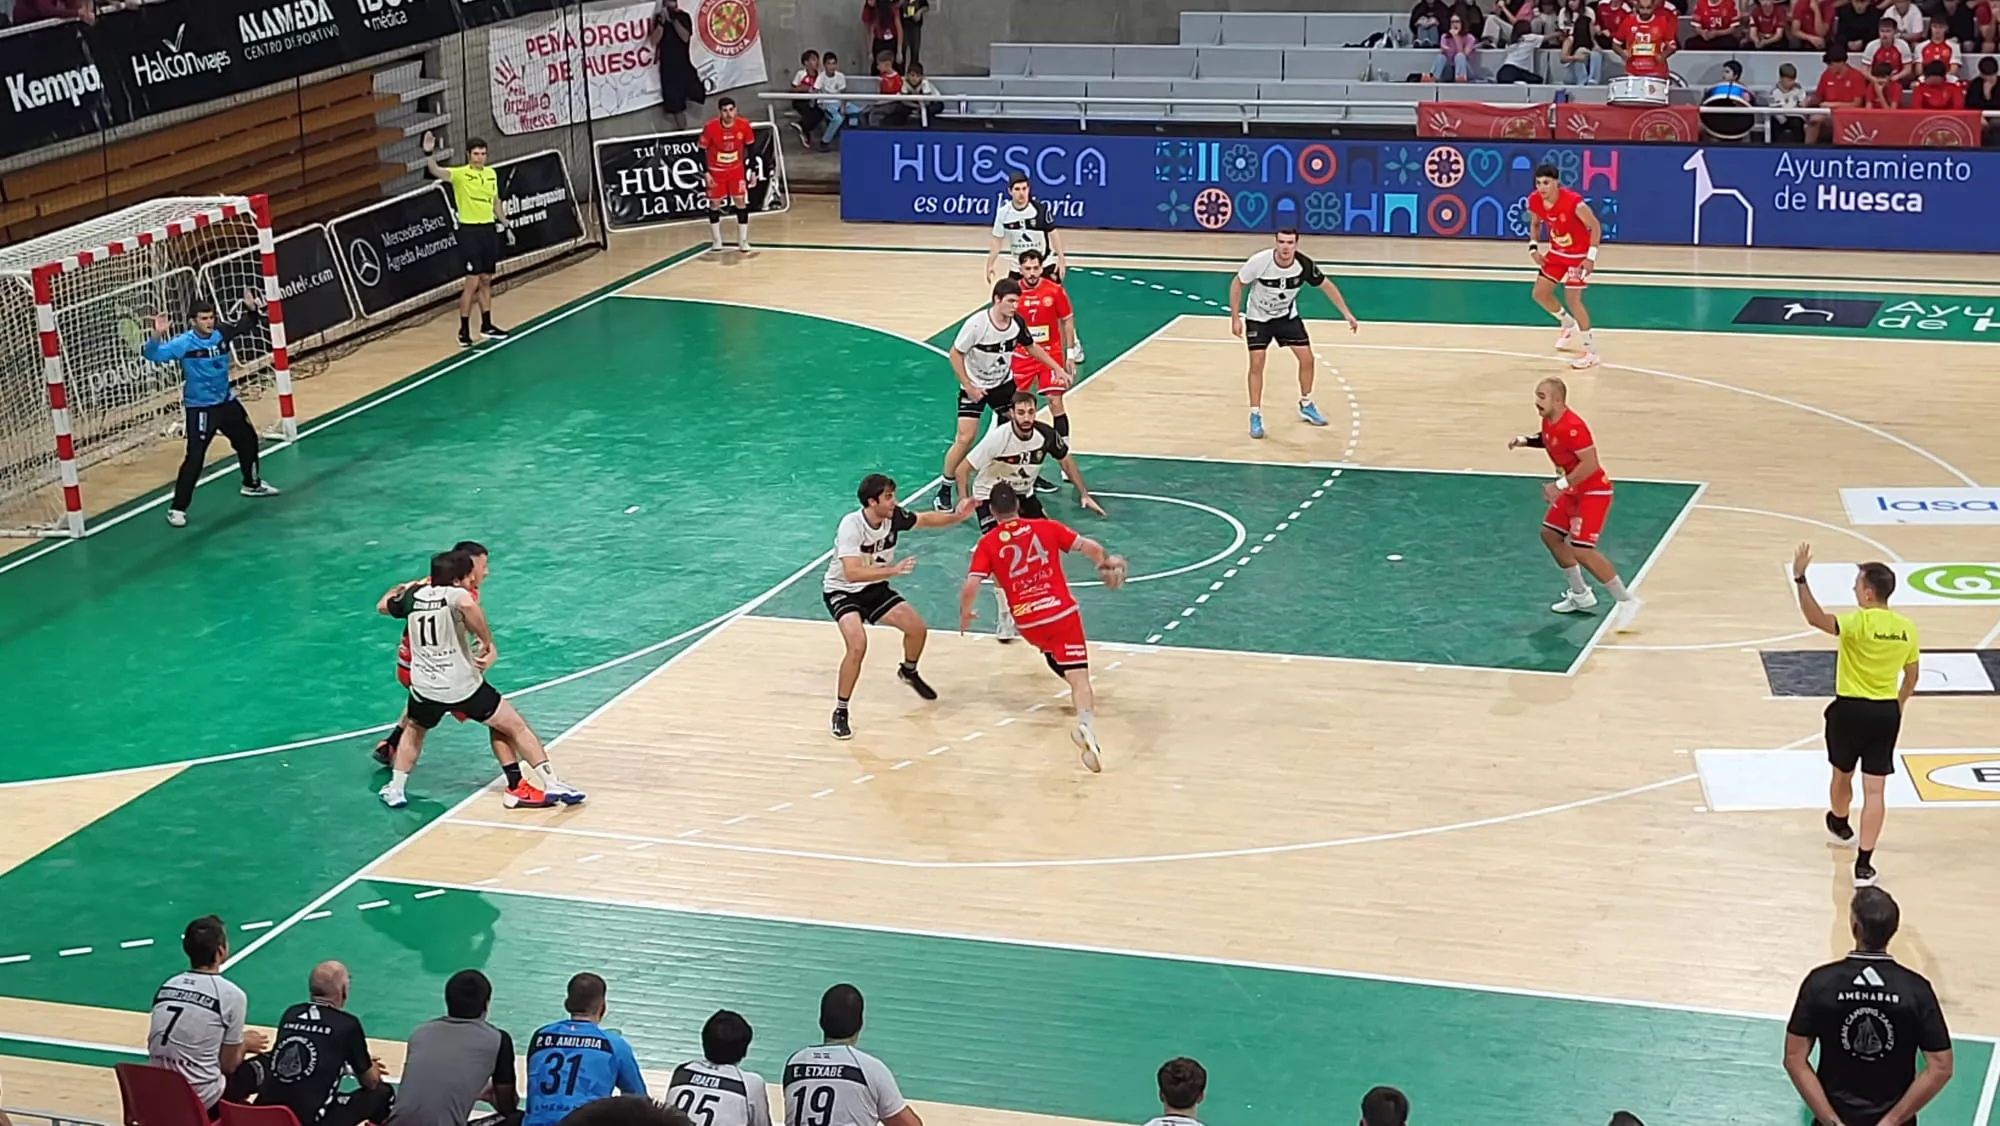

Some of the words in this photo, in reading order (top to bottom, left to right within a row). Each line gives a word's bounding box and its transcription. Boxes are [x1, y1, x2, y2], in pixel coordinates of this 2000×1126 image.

[239, 0, 334, 43] ALAMEDA
[244, 38, 283, 60] CENTRO
[285, 24, 340, 50] DEPORTIVO
[6, 64, 103, 112] Kempa
[893, 142, 1107, 187] HUESCA
[1774, 152, 1971, 185] Ayuntamiento
[641, 196, 669, 216] La
[913, 196, 937, 213] es
[943, 193, 989, 215] otra
[1774, 186, 1806, 210] de
[1817, 185, 1923, 212] Huesca
[381, 215, 447, 248] Mercedes-Benz
[1028, 309, 1037, 322] 7
[1877, 315, 1948, 330] de
[999, 533, 1048, 578] 24
[418, 615, 438, 646] 11
[1837, 990, 1900, 1004] AMENABAR
[161, 1005, 184, 1046] 7
[283, 1022, 331, 1035] AMENABAR
[556, 1036, 602, 1049] AMILIBIA
[540, 1051, 584, 1096] 31
[804, 1066, 845, 1078] ETXABE
[793, 1085, 836, 1126] 19
